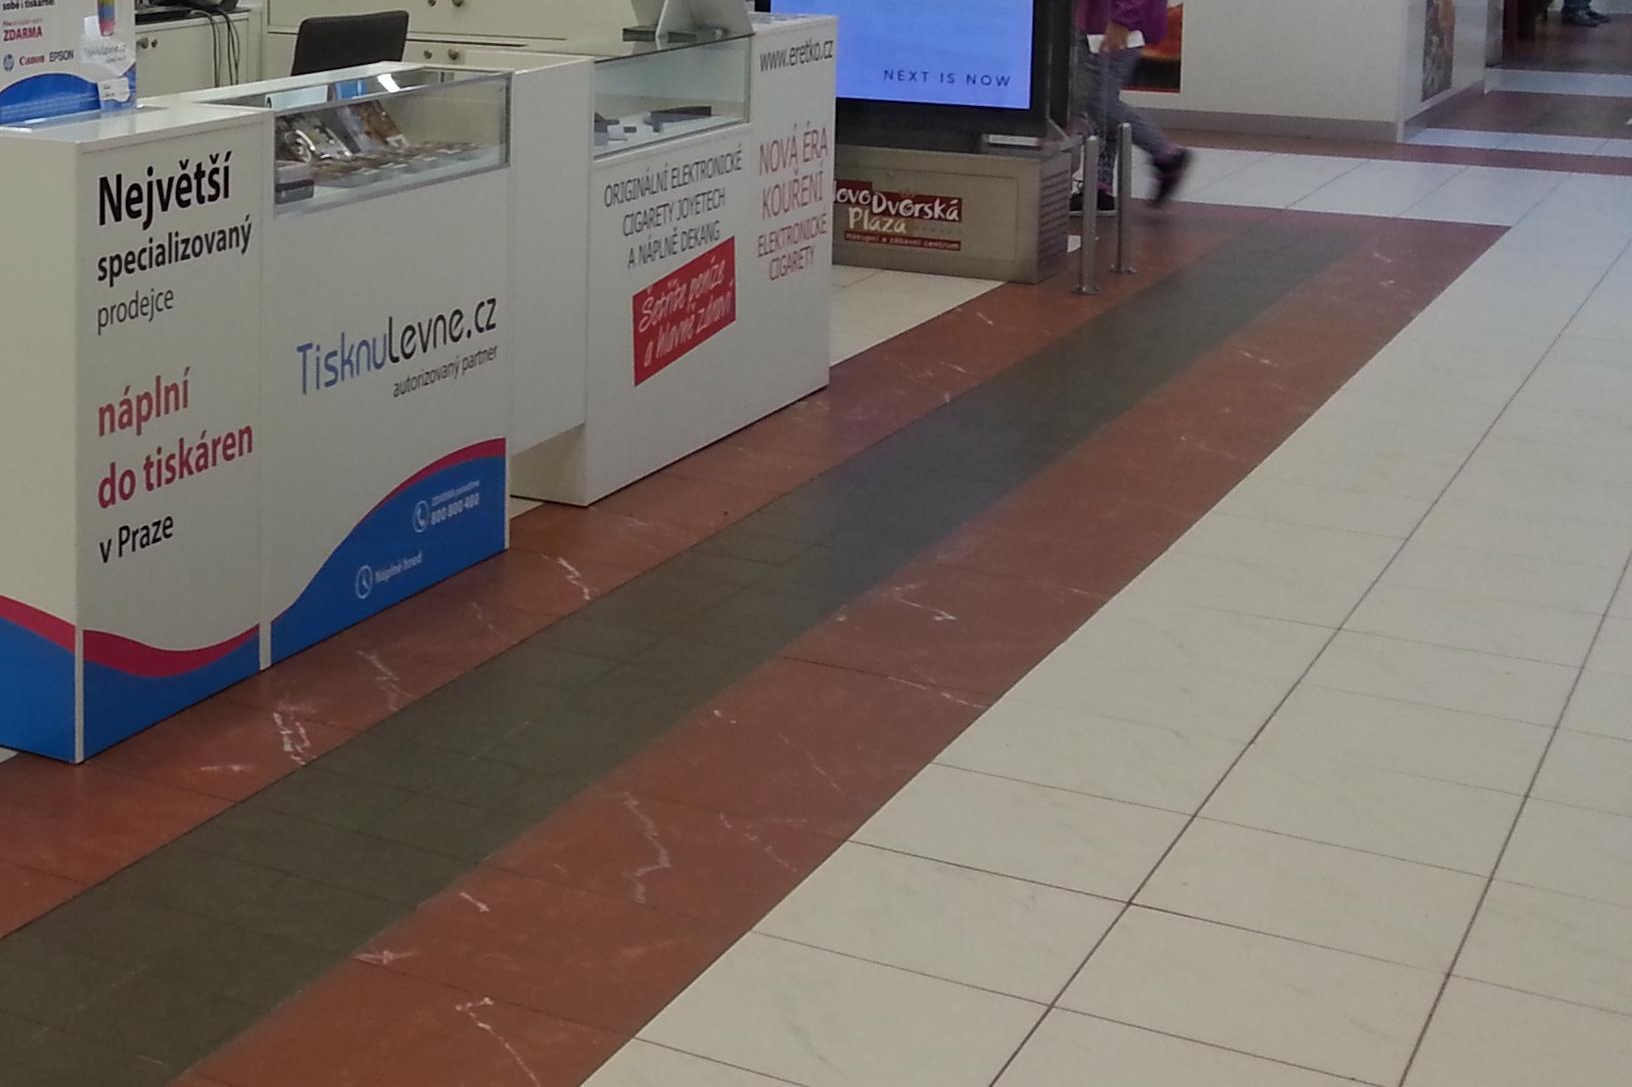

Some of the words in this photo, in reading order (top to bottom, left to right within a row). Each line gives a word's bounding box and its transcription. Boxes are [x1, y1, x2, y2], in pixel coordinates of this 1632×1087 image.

[3, 25, 43, 42] ZDARMA
[49, 49, 74, 63] EPSON
[883, 69, 930, 83] NEXT
[939, 71, 956, 84] IS
[966, 74, 1012, 88] NOW
[759, 123, 799, 177] NOVÁ
[802, 120, 829, 164] ÉRA
[98, 150, 232, 231] Největší
[603, 163, 669, 208] ORIGINÁLNÍ
[671, 143, 743, 189] ELEKTRONICKÉ
[762, 164, 825, 220] KOUŘENÍ
[623, 202, 674, 237] CIGARETY
[676, 187, 726, 221] JOYETECH
[757, 207, 828, 258] ELEKTRONICKÉ
[848, 206, 907, 233] Plaza
[97, 214, 253, 288] specializovaný
[627, 247, 637, 269] A
[638, 226, 679, 265] NÁPLNĚ
[681, 220, 721, 253] DEKANG
[769, 245, 816, 281] CIGARETY
[97, 287, 174, 336] prodejce
[392, 354, 461, 398] autorizovaný
[461, 345, 498, 376] partner
[98, 366, 191, 438] náplní
[98, 461, 136, 509] do
[143, 424, 254, 492] tiskáren
[99, 538, 112, 564] v
[118, 515, 174, 558] Praze
